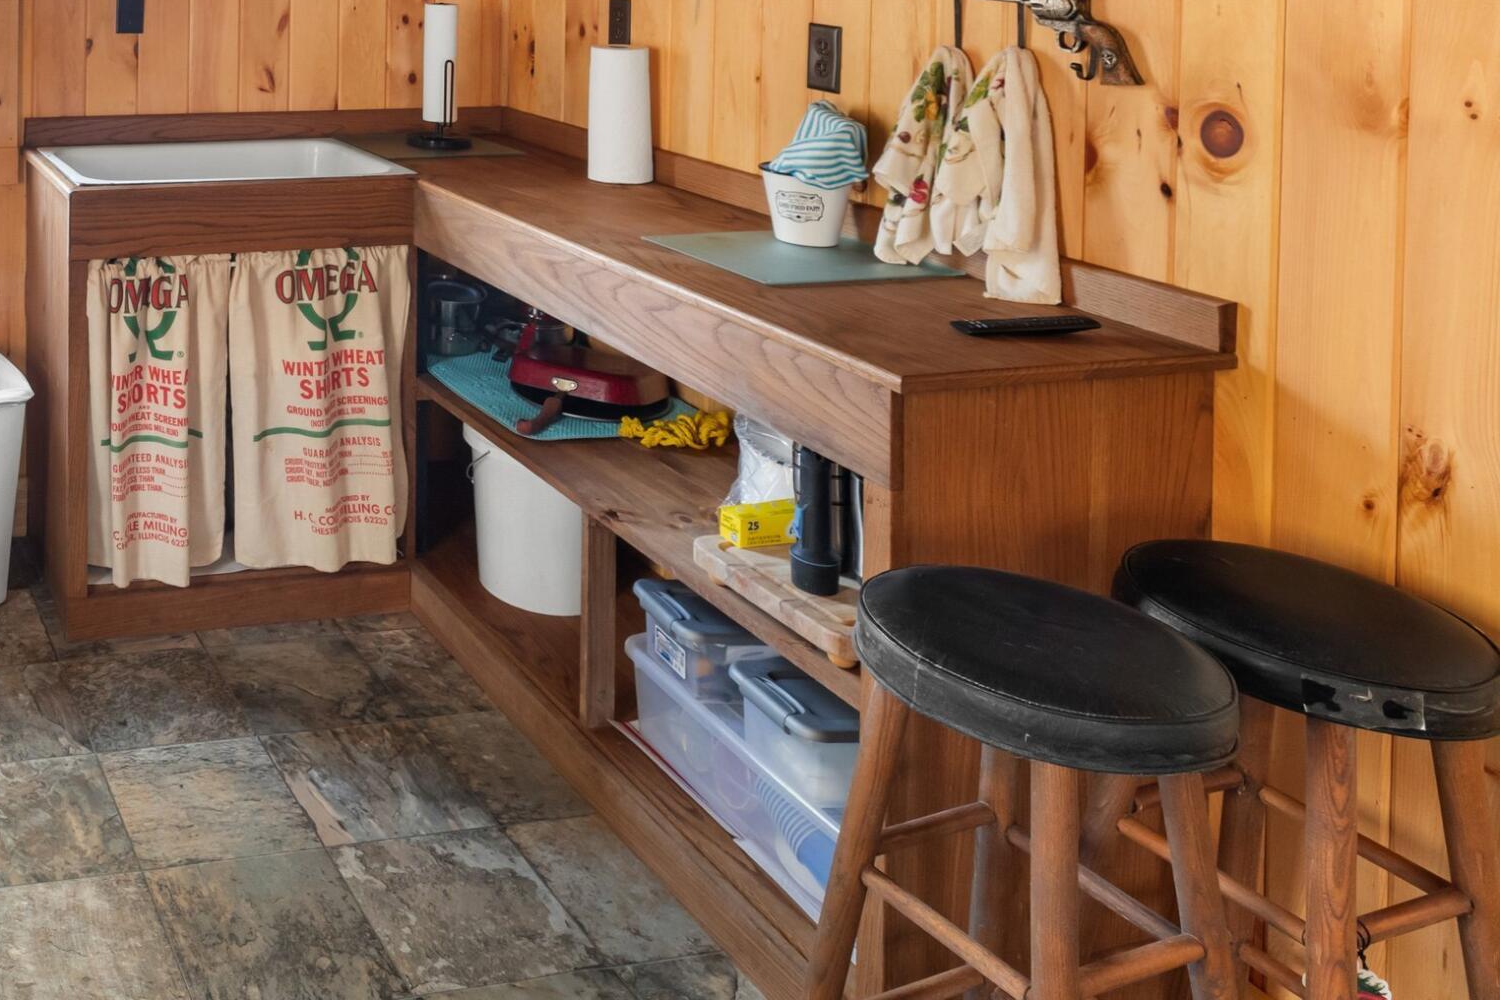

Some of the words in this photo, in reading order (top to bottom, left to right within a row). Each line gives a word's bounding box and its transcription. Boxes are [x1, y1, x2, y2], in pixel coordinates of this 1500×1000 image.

[275, 261, 378, 304] OMEGA
[109, 274, 189, 314] OMGA
[332, 349, 384, 367] WHEAT
[286, 404, 323, 417] GROUND
[336, 395, 389, 406] SCREENINGS
[340, 436, 381, 447] ANALYSIS
[156, 454, 188, 469] ANALYSI
[143, 520, 188, 538] MILLING
[747, 521, 760, 531] 25
